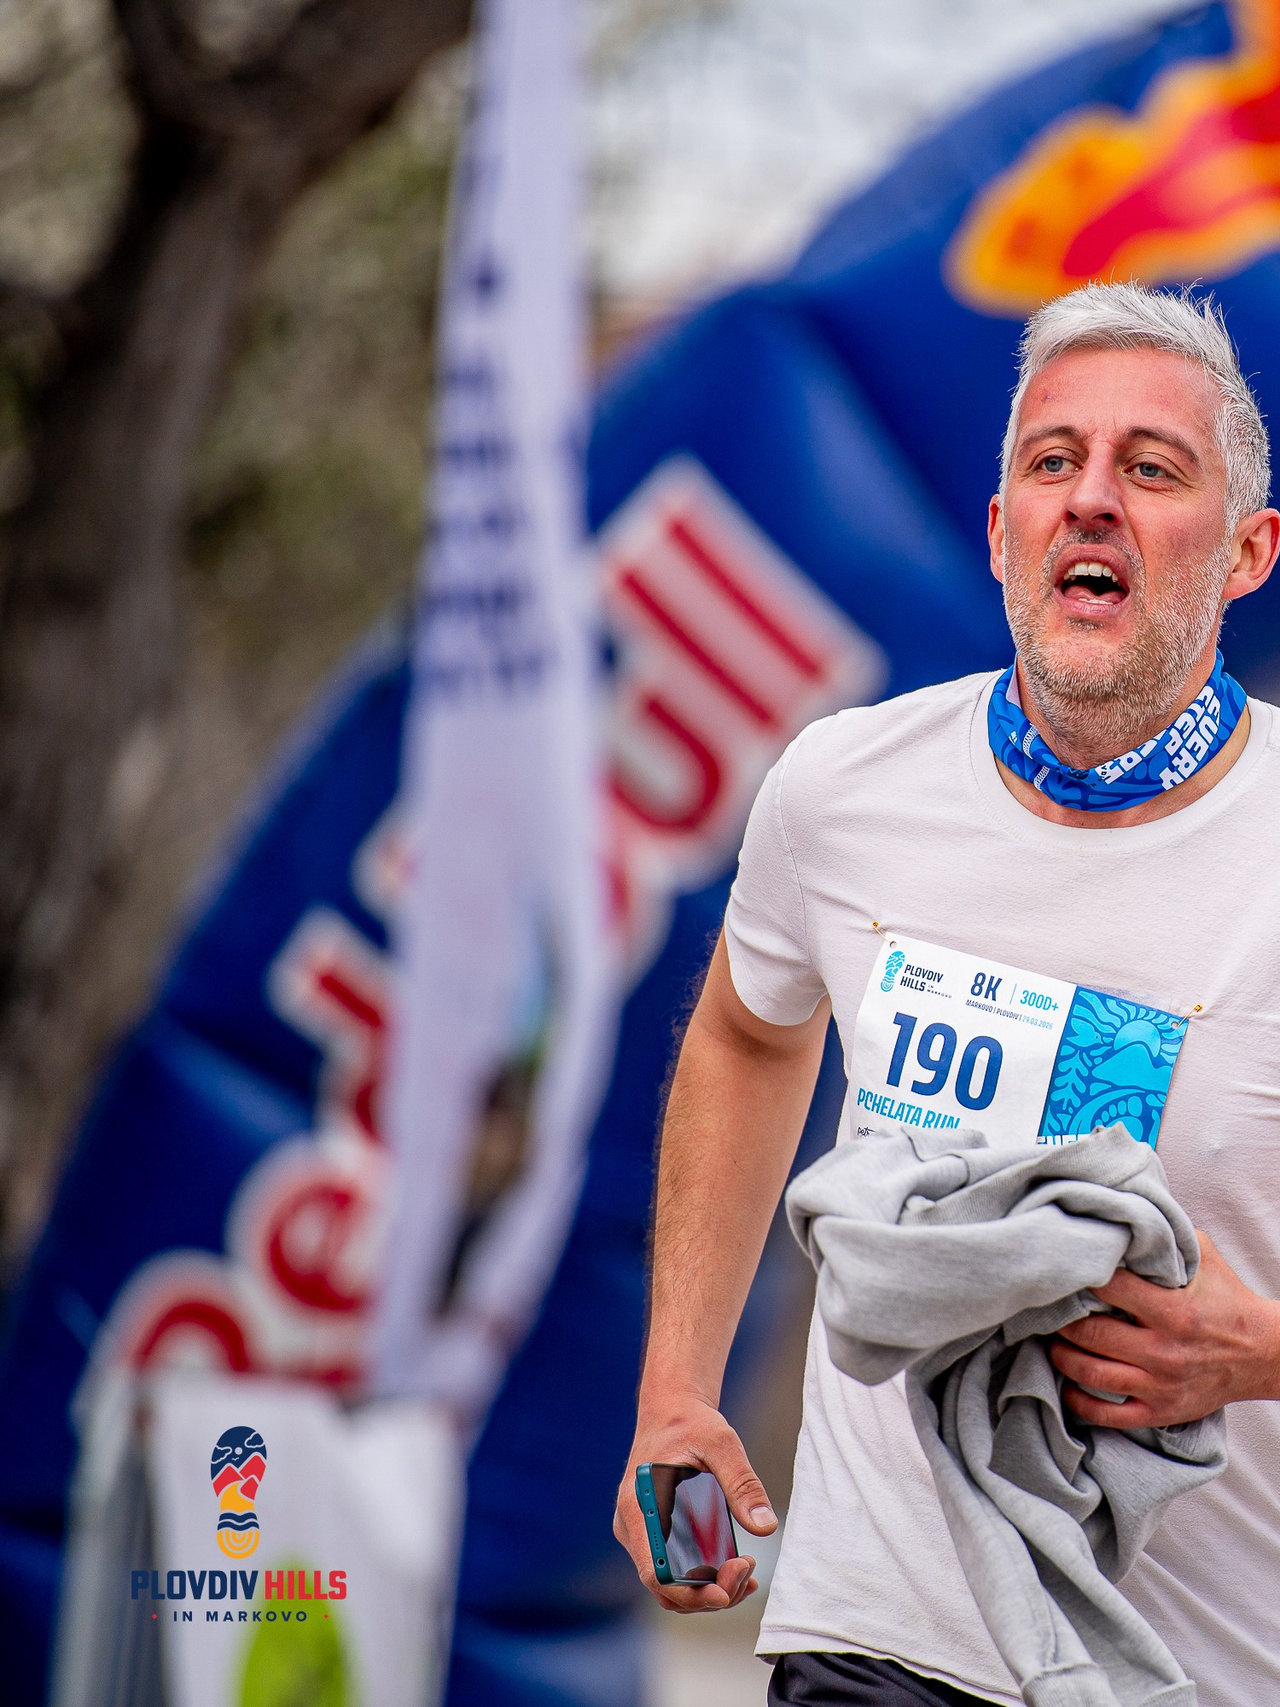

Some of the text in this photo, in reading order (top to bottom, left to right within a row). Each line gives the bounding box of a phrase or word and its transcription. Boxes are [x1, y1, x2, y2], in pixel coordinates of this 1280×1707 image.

[900, 976, 926, 992] HILLS
[904, 964, 944, 983] PLOVDIV
[970, 972, 1059, 1011] 8K 300D+
[965, 999, 993, 1013] MARKOVO
[996, 1008, 1020, 1020] PLOVDIV
[886, 1011, 1004, 1111] 190
[857, 1087, 923, 1126] PCHELATA
